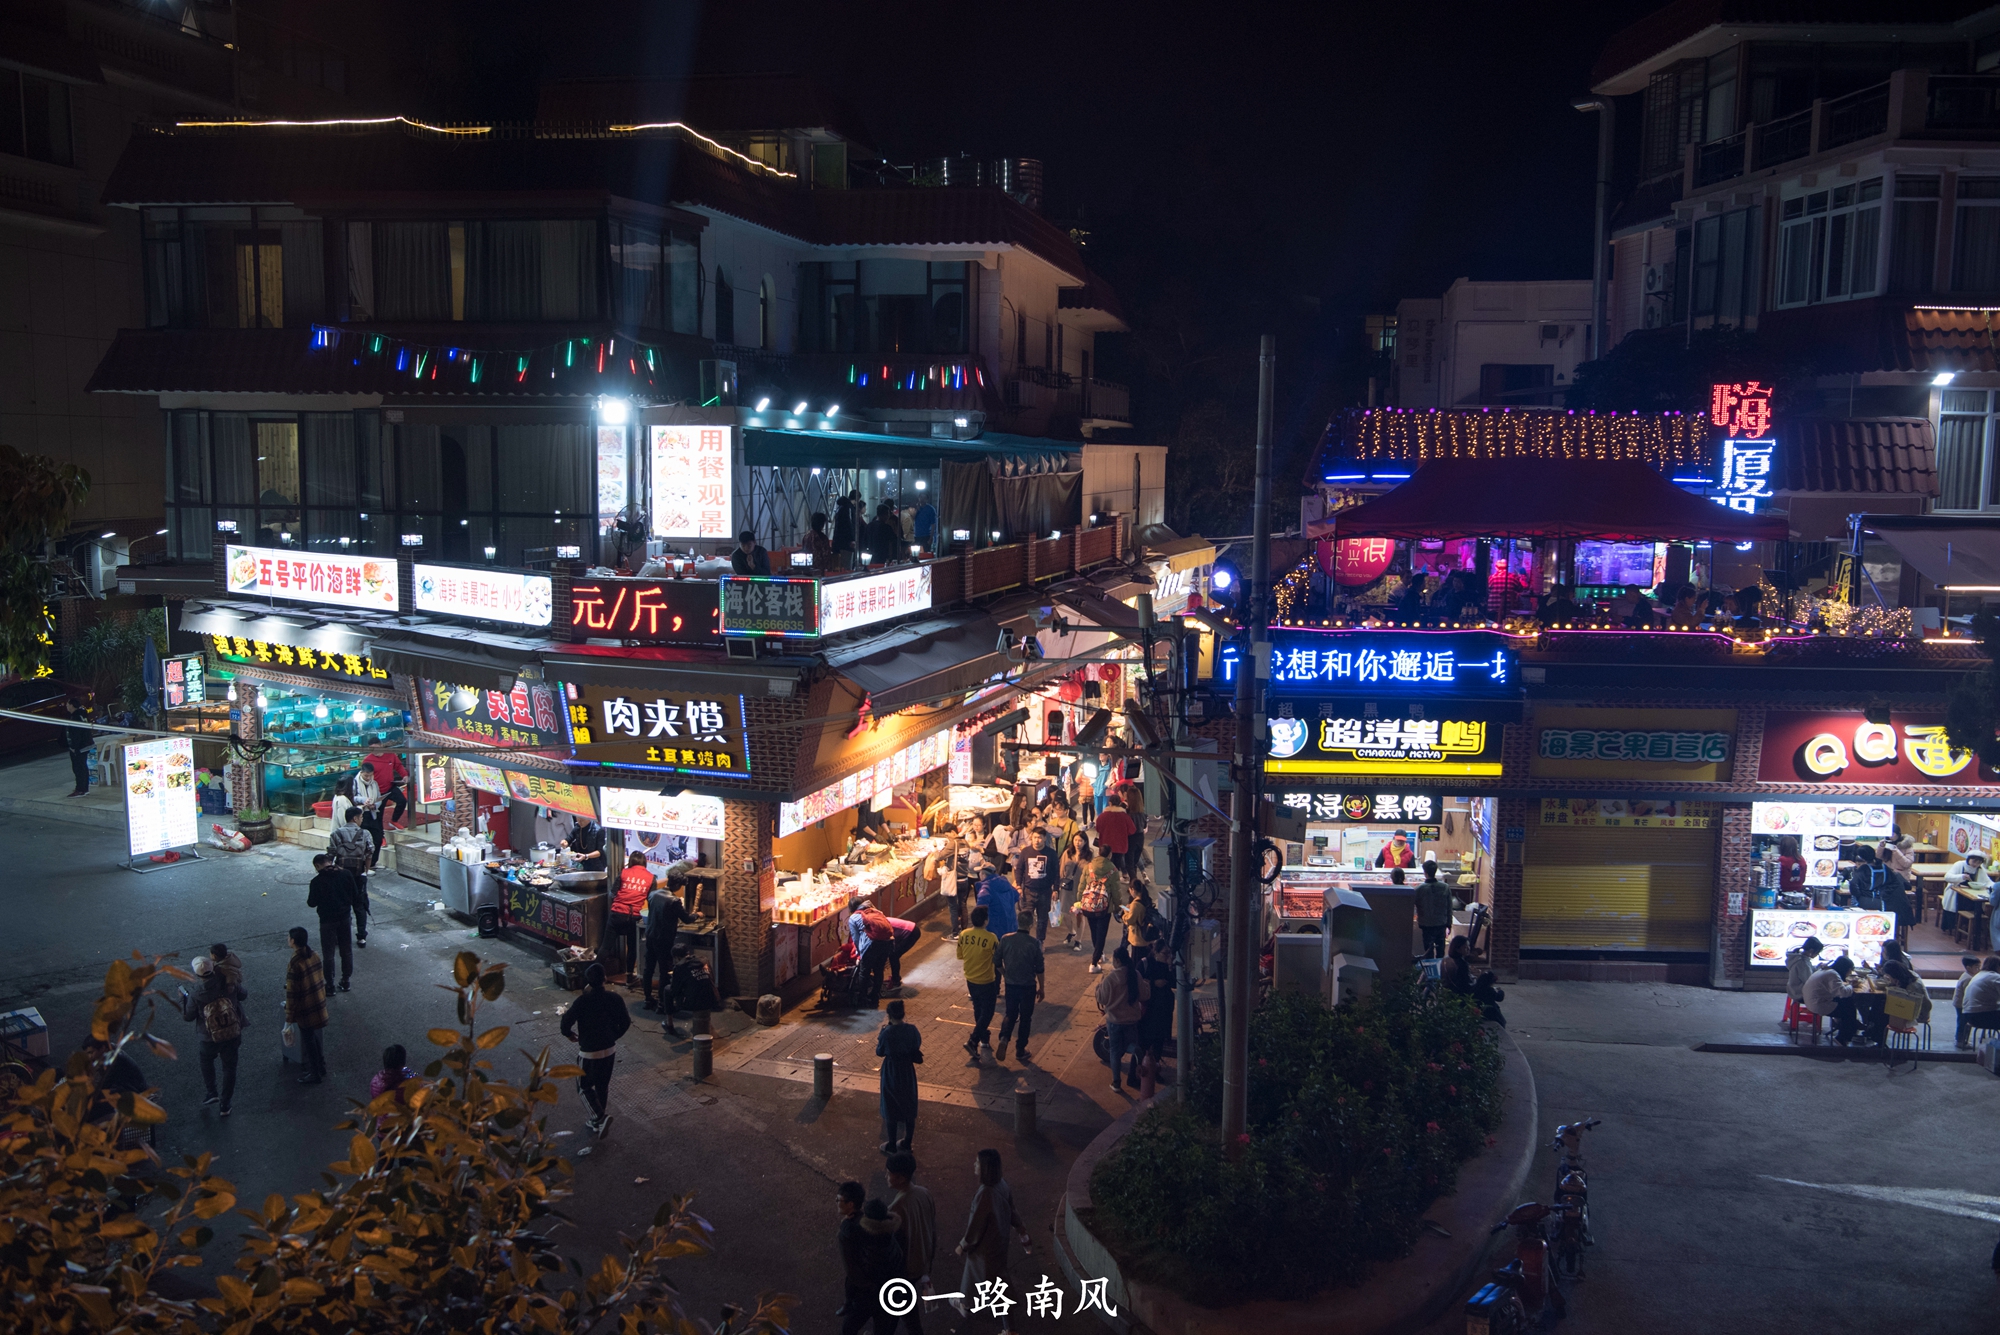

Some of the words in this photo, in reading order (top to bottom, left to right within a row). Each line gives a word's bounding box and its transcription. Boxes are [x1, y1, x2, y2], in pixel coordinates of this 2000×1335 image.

[698, 429, 726, 534] 用餐观景
[259, 558, 362, 596] 五号平价海鲜
[439, 577, 457, 603] 海鲜
[460, 580, 499, 609] 海景阳台
[725, 583, 805, 617] 海伦客栈
[835, 591, 856, 620] 海鲜
[857, 585, 896, 614] 海景阳台
[898, 579, 917, 605] 川菜
[724, 617, 805, 631] 0592-5666635
[166, 660, 185, 706] 超市
[185, 658, 204, 703] 足疗采耳
[569, 704, 592, 745] 胖姐
[602, 696, 727, 744] 肉夹馍
[1277, 702, 1426, 719] 超浔黑鸭
[1322, 718, 1485, 752] 超浔黑鸭
[1539, 729, 1730, 763] 海景芒果直营店
[646, 746, 732, 769] 土耳其烤肉
[1372, 793, 1432, 820] 黑鸭
[1544, 811, 1569, 824] 拼盘
